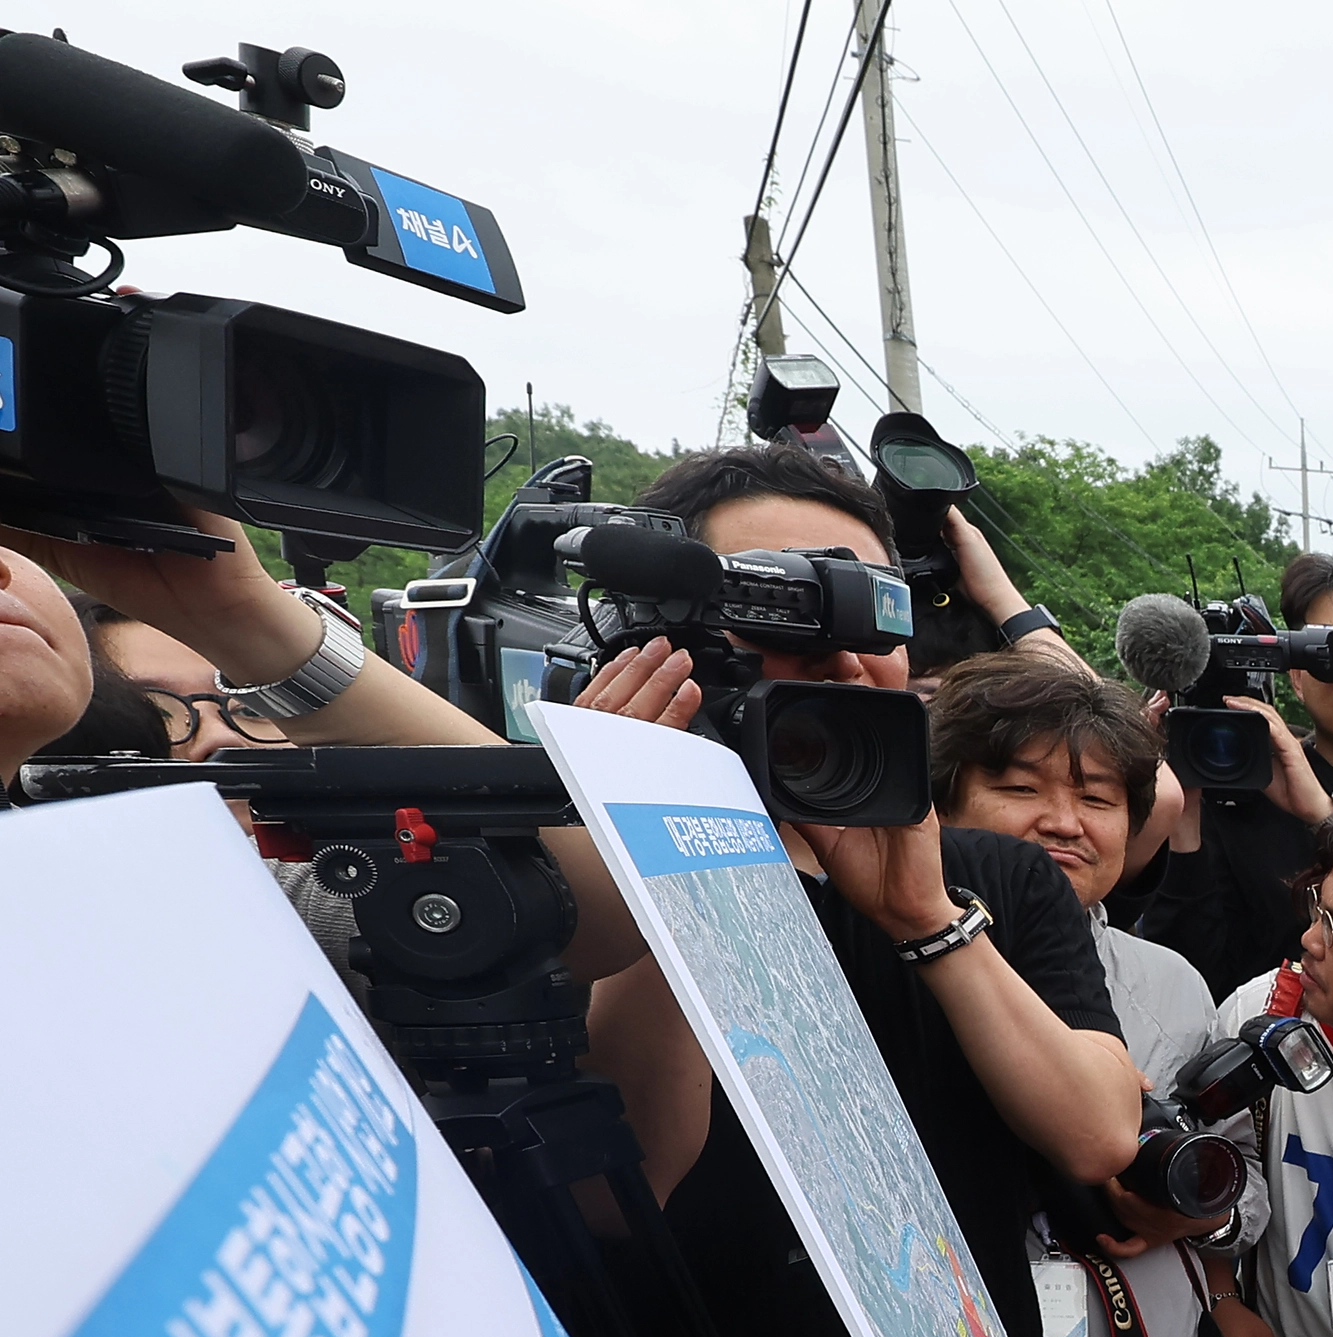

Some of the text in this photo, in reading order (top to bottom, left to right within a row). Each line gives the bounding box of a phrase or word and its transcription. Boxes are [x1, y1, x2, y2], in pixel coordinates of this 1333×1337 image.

[309, 178, 346, 198] ONY
[731, 560, 786, 575] Panasonic
[1217, 637, 1243, 645] SONY
